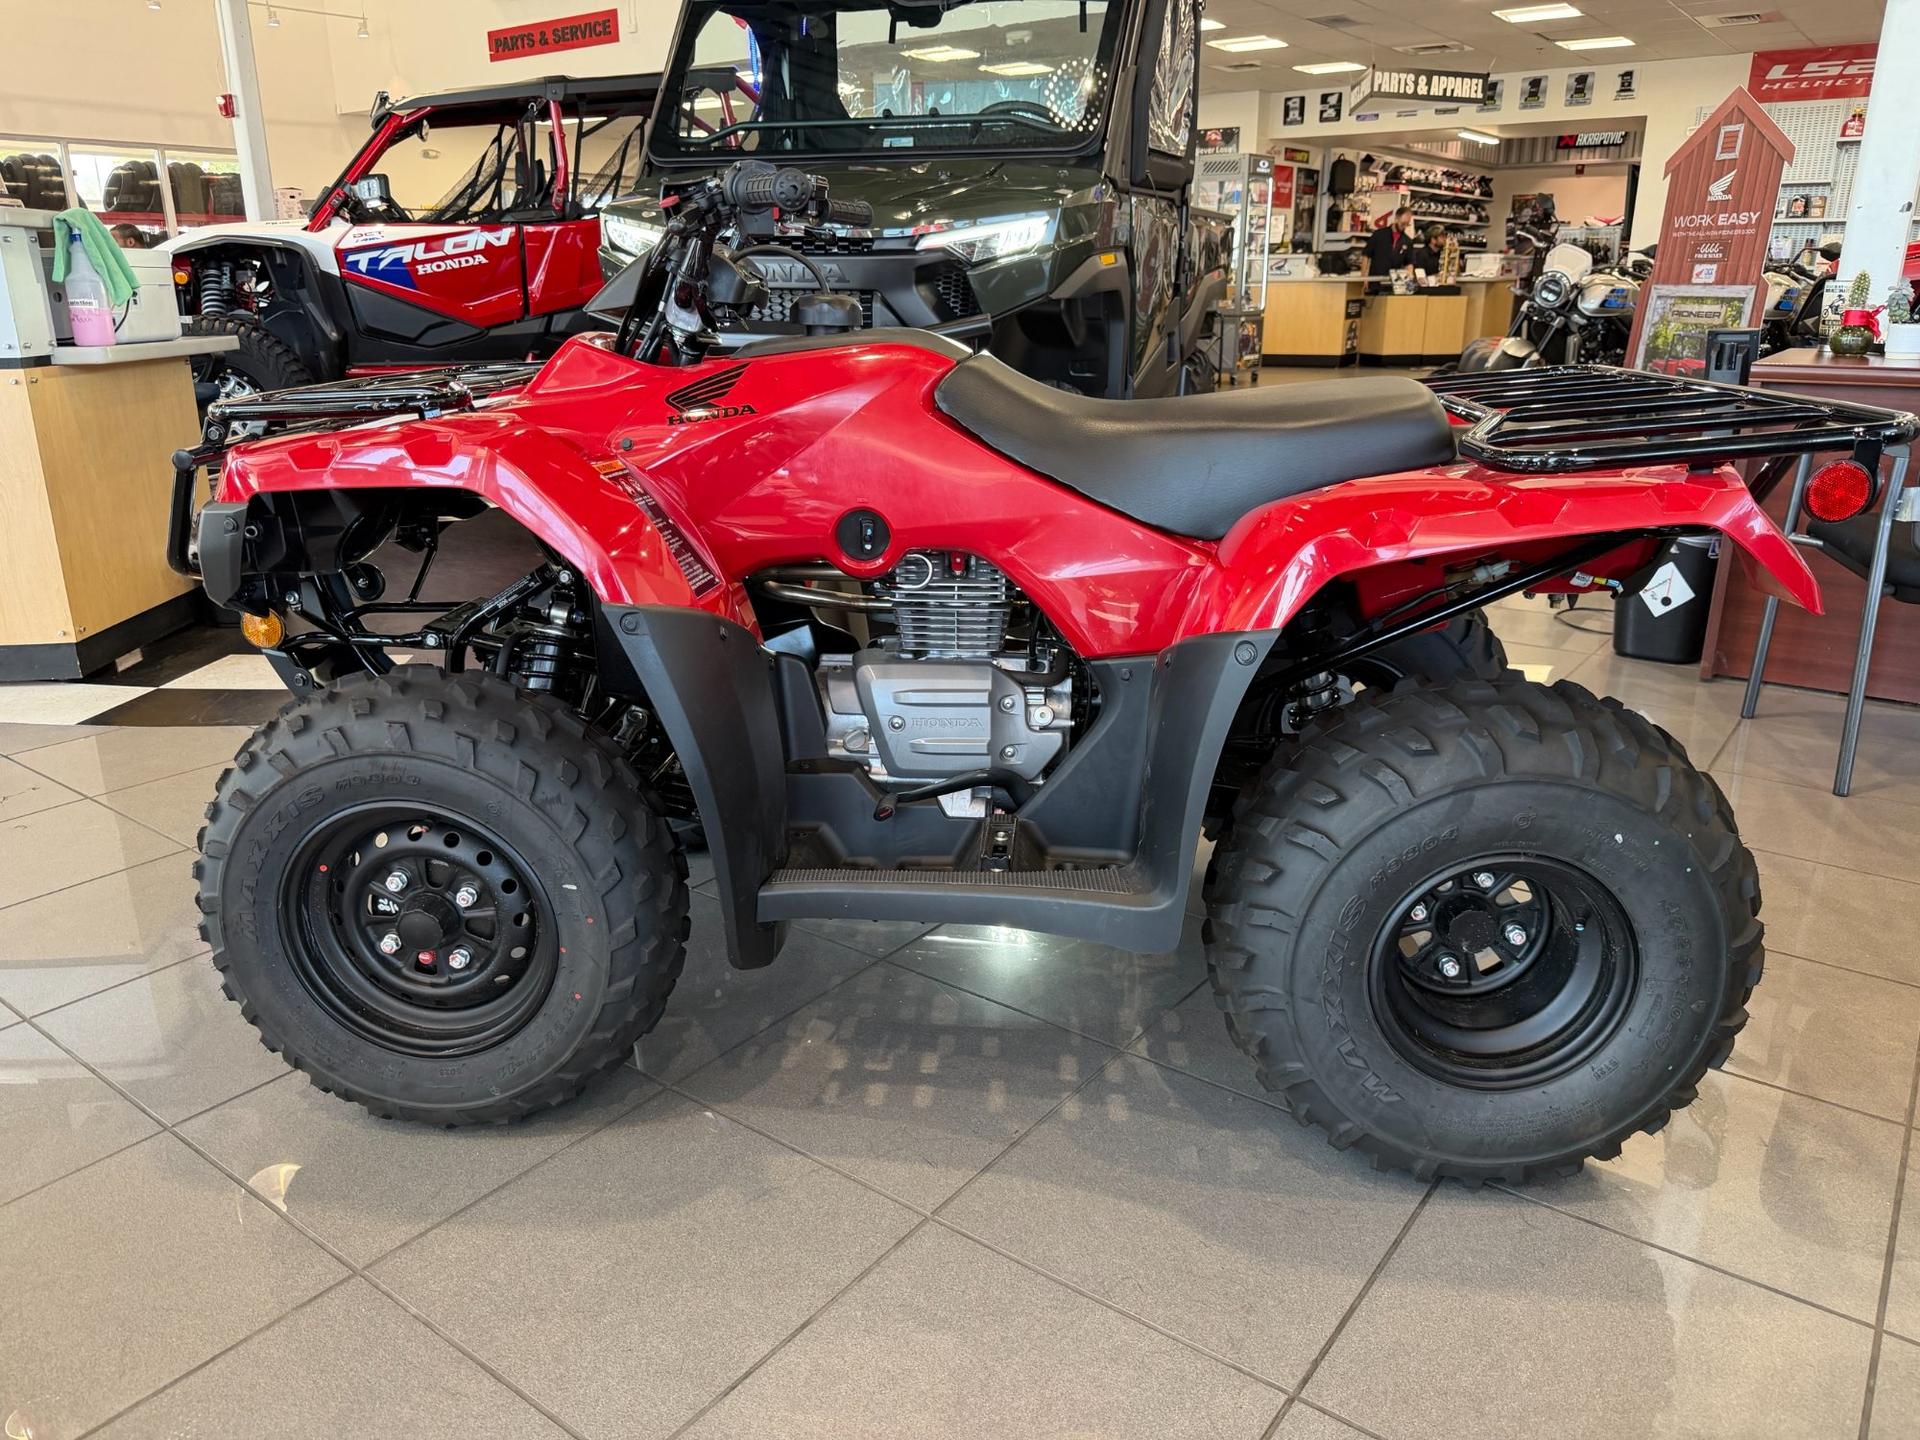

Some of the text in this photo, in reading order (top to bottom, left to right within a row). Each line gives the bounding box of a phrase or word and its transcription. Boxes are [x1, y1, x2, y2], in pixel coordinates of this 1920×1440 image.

[494, 19, 612, 53] PARTS & SERVICE
[1373, 71, 1415, 95] PARTS
[1416, 75, 1428, 95] &
[1429, 75, 1483, 99] APPAREL
[1761, 77, 1873, 91] HELMET
[1674, 211, 1761, 228] WORK EASY
[346, 227, 513, 273] TALON
[416, 254, 489, 275] HONDA
[1671, 310, 1722, 319] PIONEER
[667, 404, 758, 426] HONDA
[910, 717, 984, 729] HONDA
[238, 783, 326, 944] MAXXIS
[1321, 894, 1406, 1102] MAXXIS
